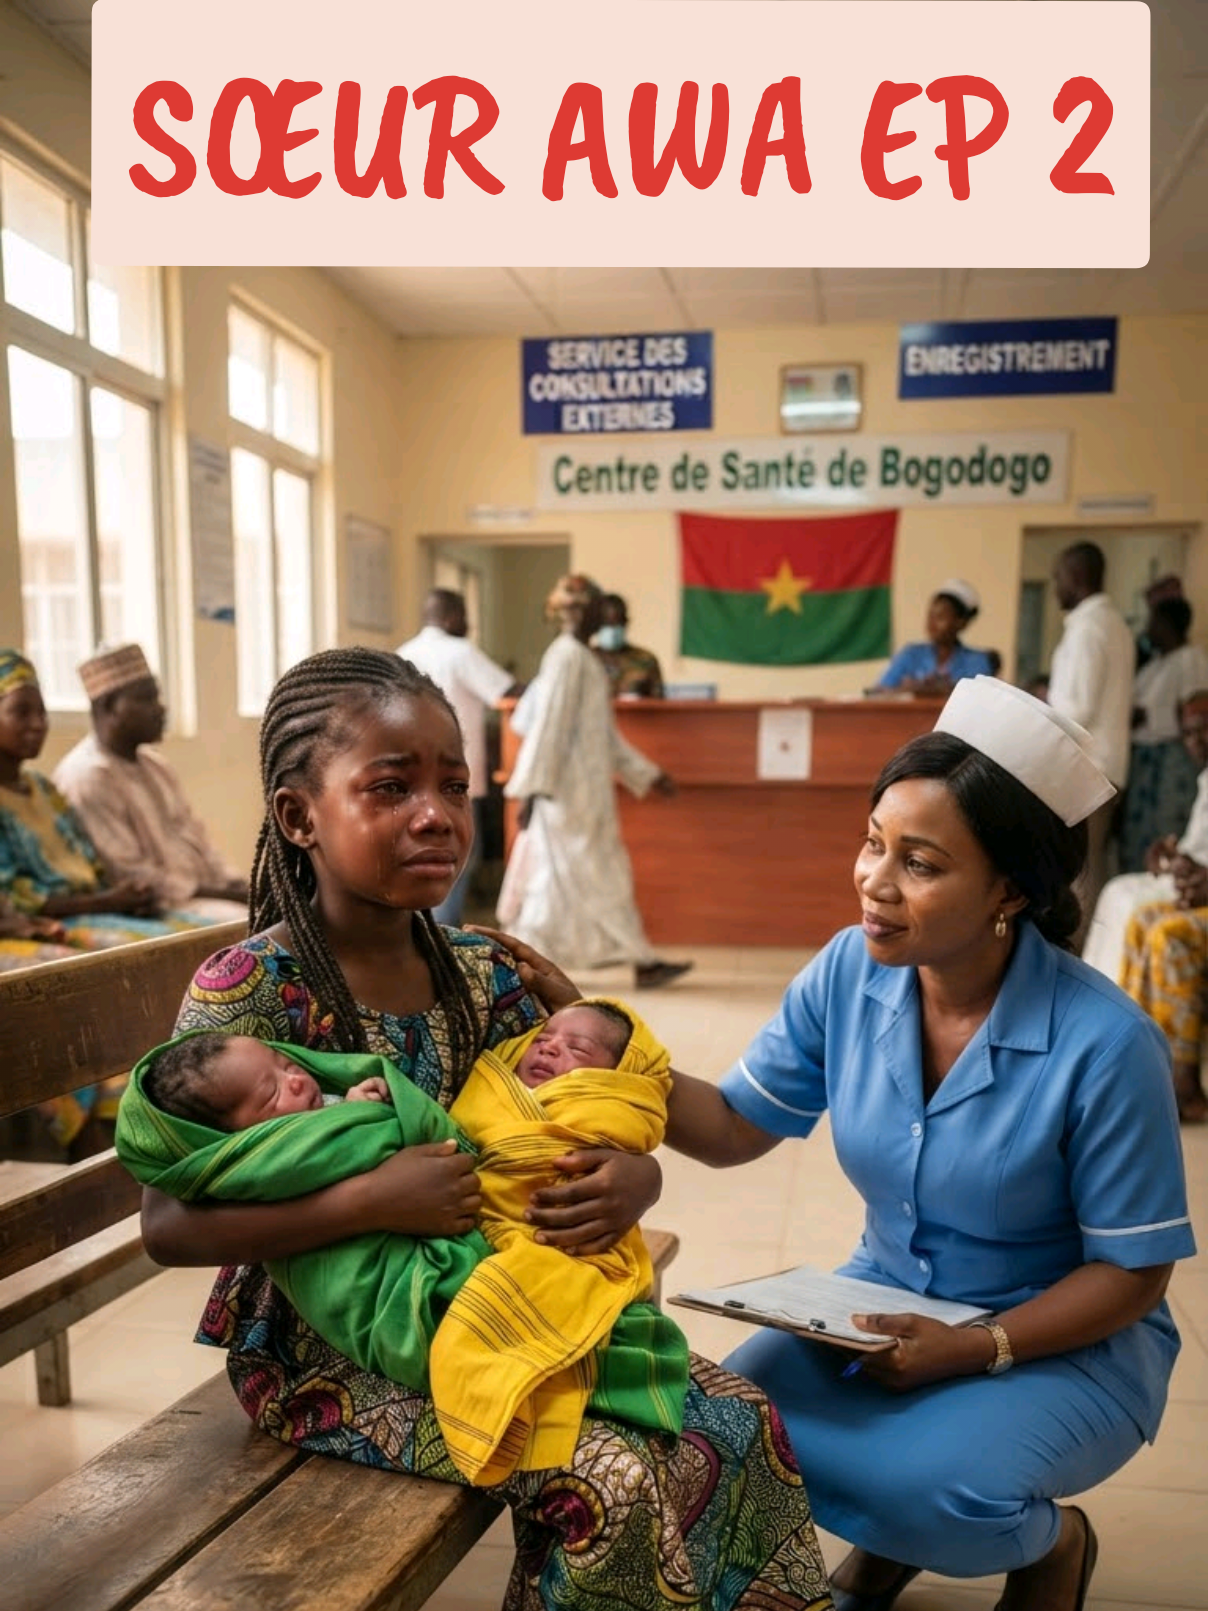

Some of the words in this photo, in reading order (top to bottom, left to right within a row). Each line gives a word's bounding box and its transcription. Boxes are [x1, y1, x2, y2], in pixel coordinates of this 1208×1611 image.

[547, 339, 640, 369] SERVICE
[643, 336, 688, 366] DES
[905, 338, 1109, 376] ENREGISTREMENT
[529, 366, 707, 402] CONSULTATIONS
[561, 401, 675, 431] EXTERNES
[554, 455, 659, 494] Centre
[671, 453, 709, 490] de
[721, 446, 815, 490] Santé
[828, 450, 867, 488] de
[880, 445, 1051, 497] Bogodogo
